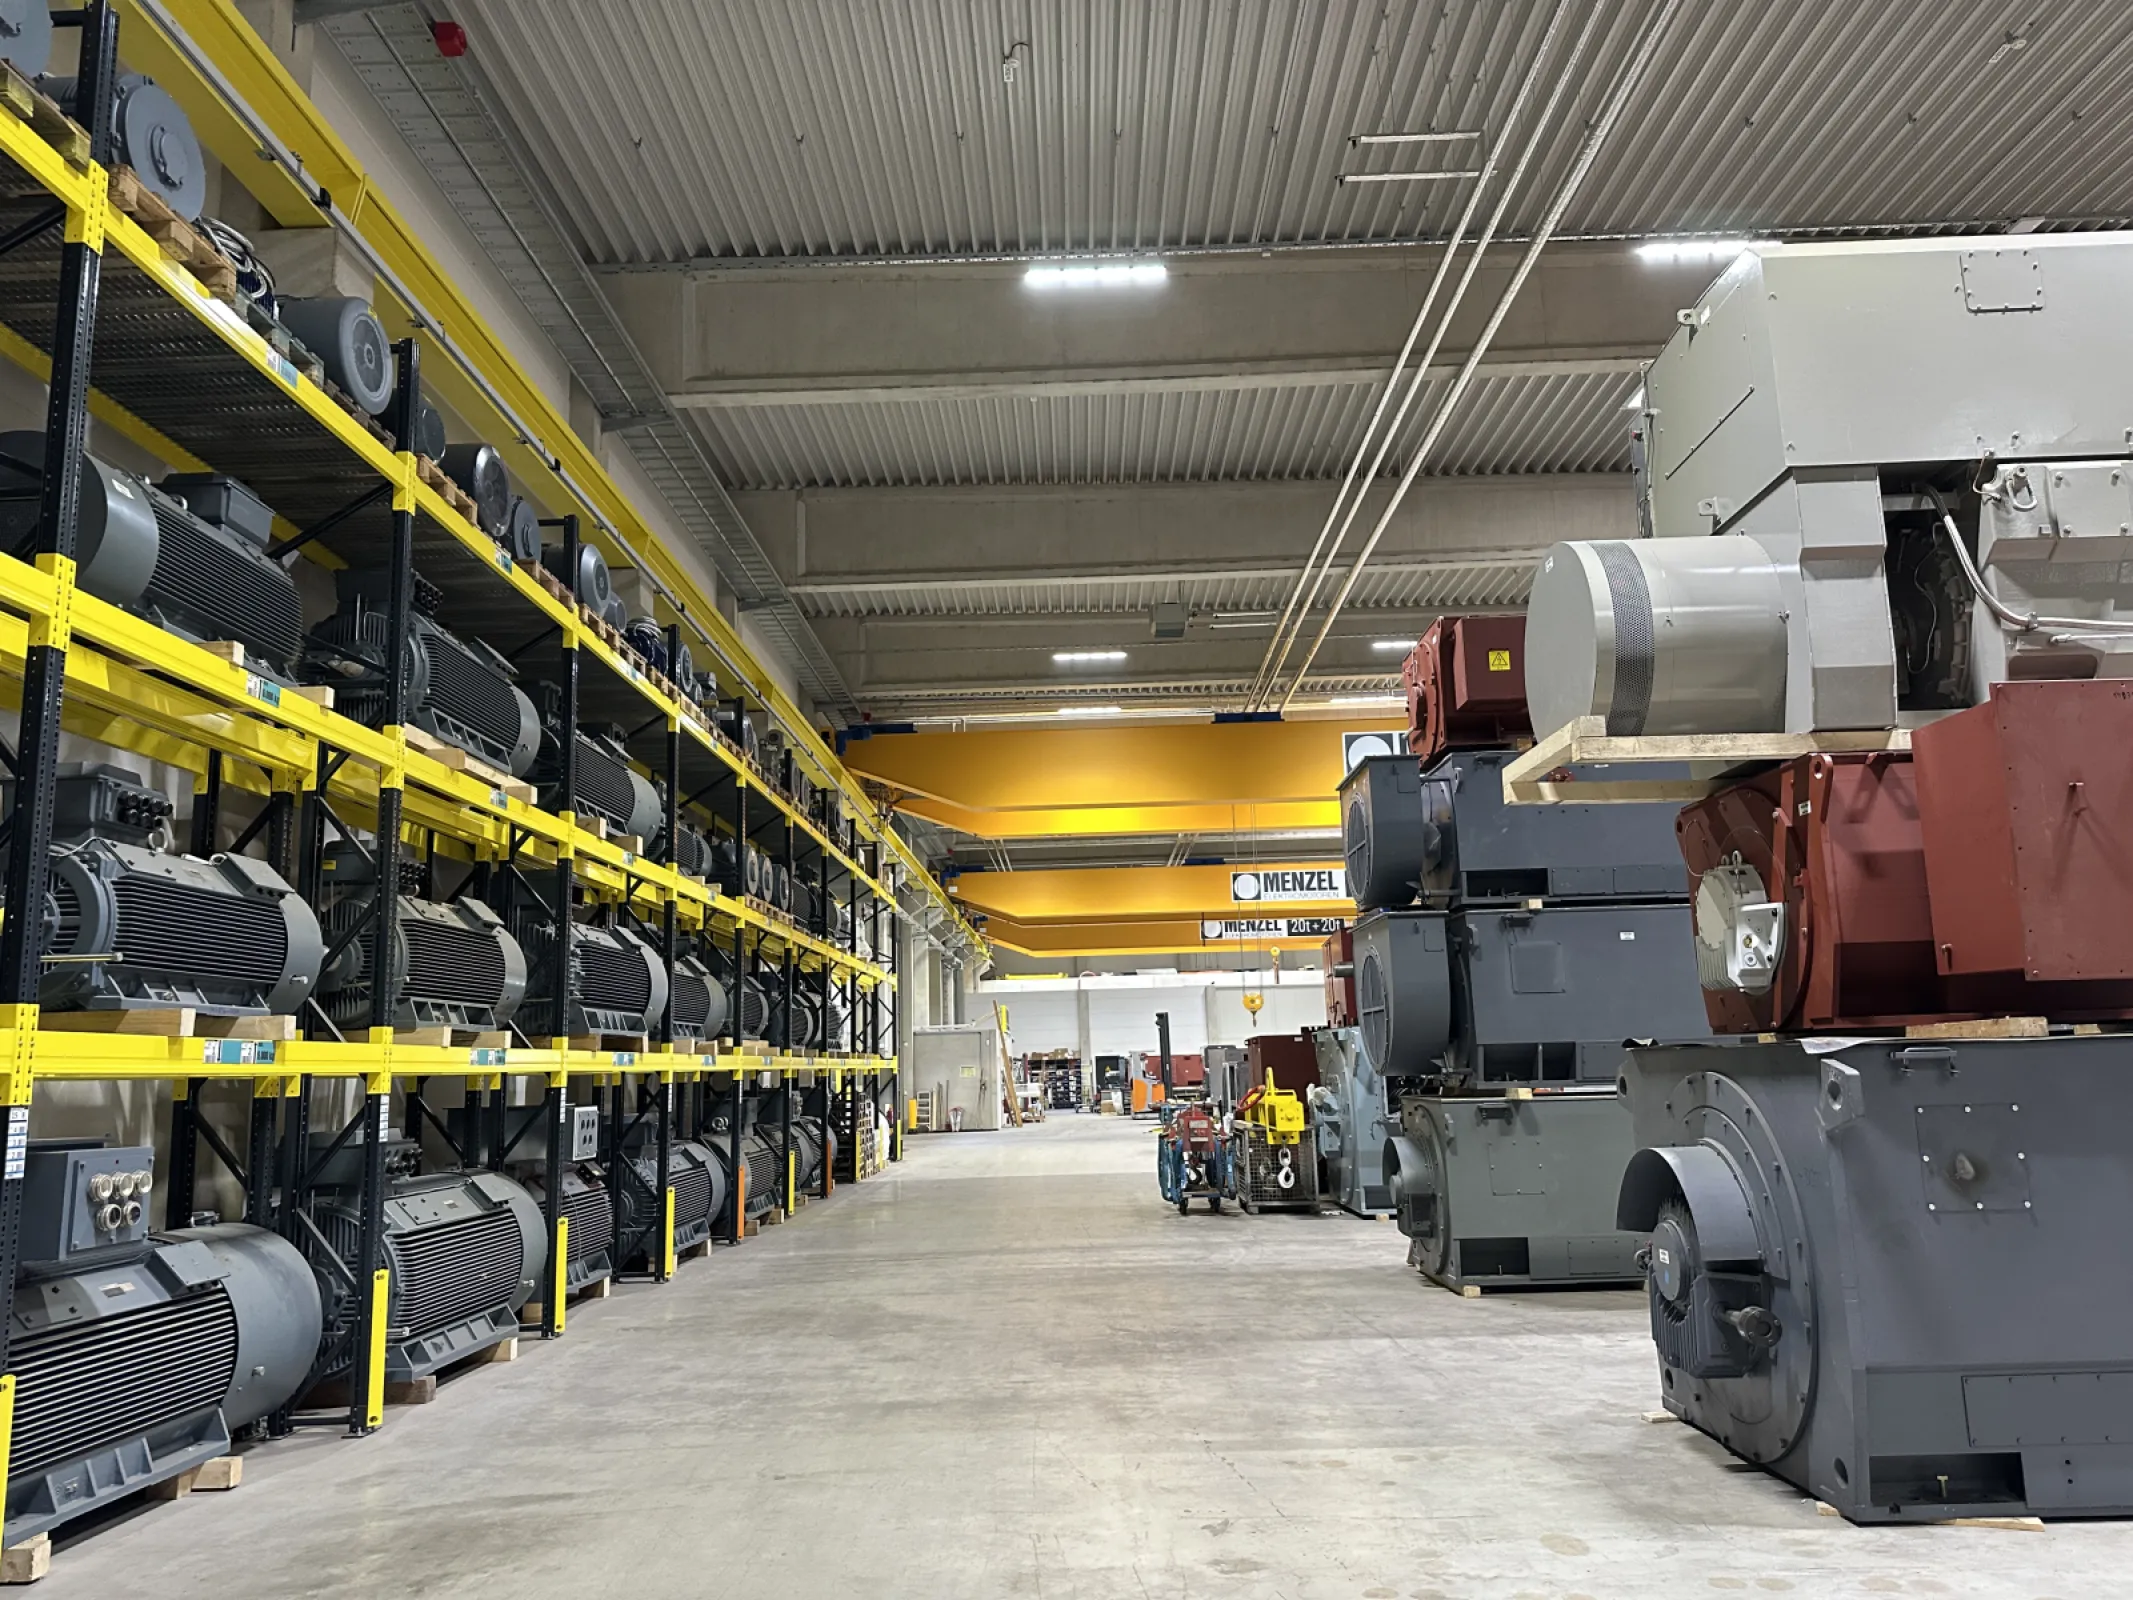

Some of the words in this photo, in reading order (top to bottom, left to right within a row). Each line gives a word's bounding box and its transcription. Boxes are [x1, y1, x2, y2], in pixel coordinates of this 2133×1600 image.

[1264, 870, 1338, 892] MENZEL
[1225, 920, 1281, 932] MENZEL
[1291, 919, 1310, 932] 20t
[1322, 918, 1340, 932] 20t
